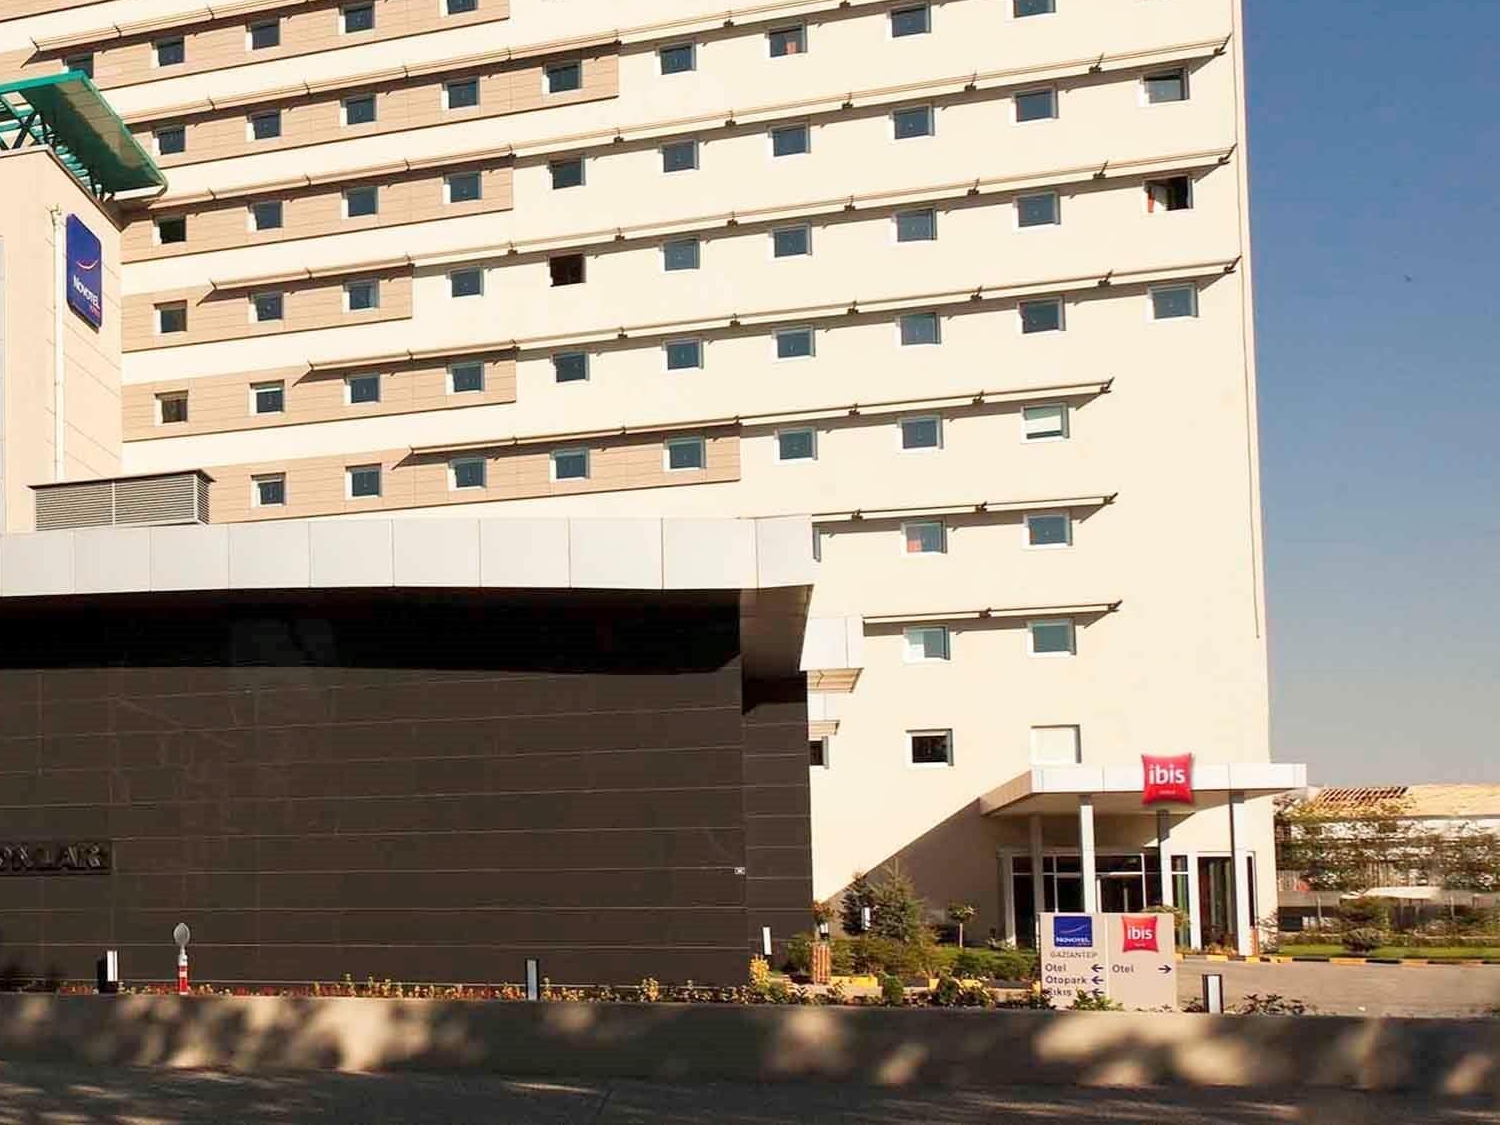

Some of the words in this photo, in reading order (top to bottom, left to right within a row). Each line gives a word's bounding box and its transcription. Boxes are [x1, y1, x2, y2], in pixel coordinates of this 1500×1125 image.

[1148, 763, 1186, 785] ibis
[1127, 926, 1153, 940] ibis
[1045, 963, 1067, 972] Otel
[1112, 964, 1135, 973] Otel
[1045, 975, 1088, 985] Otopark
